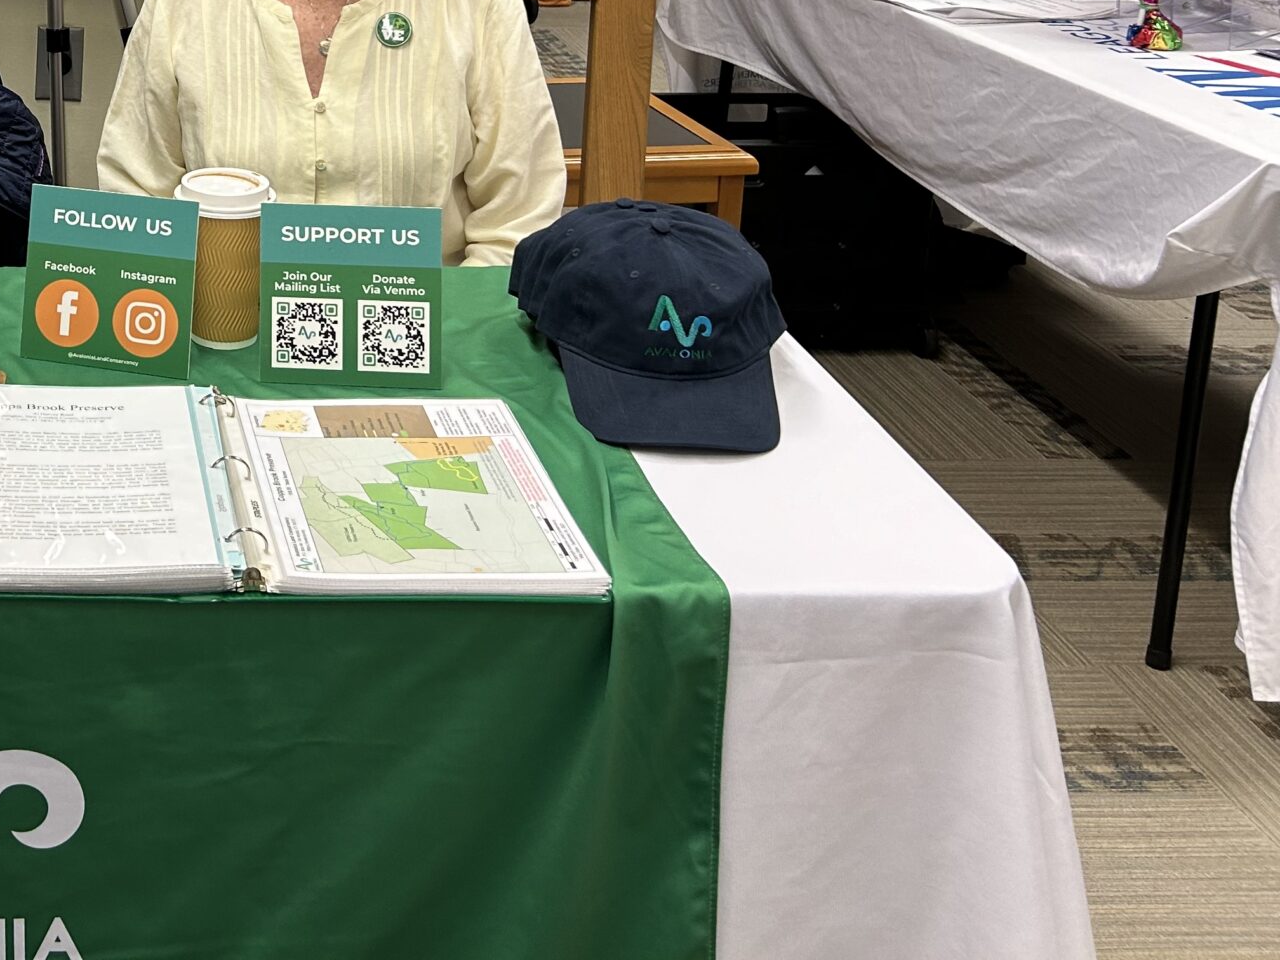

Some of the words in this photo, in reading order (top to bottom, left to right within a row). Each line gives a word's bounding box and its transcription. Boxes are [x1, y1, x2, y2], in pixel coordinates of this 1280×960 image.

[53, 208, 138, 233] FOLLOW
[145, 218, 173, 237] US
[280, 225, 382, 245] SUPPORT
[390, 229, 420, 246] US
[44, 260, 97, 276] Facebook
[120, 269, 177, 286] Instagram
[282, 271, 311, 283] Join
[314, 272, 333, 282] Our
[372, 273, 416, 286] Donate
[274, 281, 318, 295] Mailing
[320, 282, 341, 294] List
[361, 284, 379, 296] Via
[381, 286, 426, 297] Venmo
[26, 403, 66, 411] Brook
[70, 403, 125, 411] Preserve
